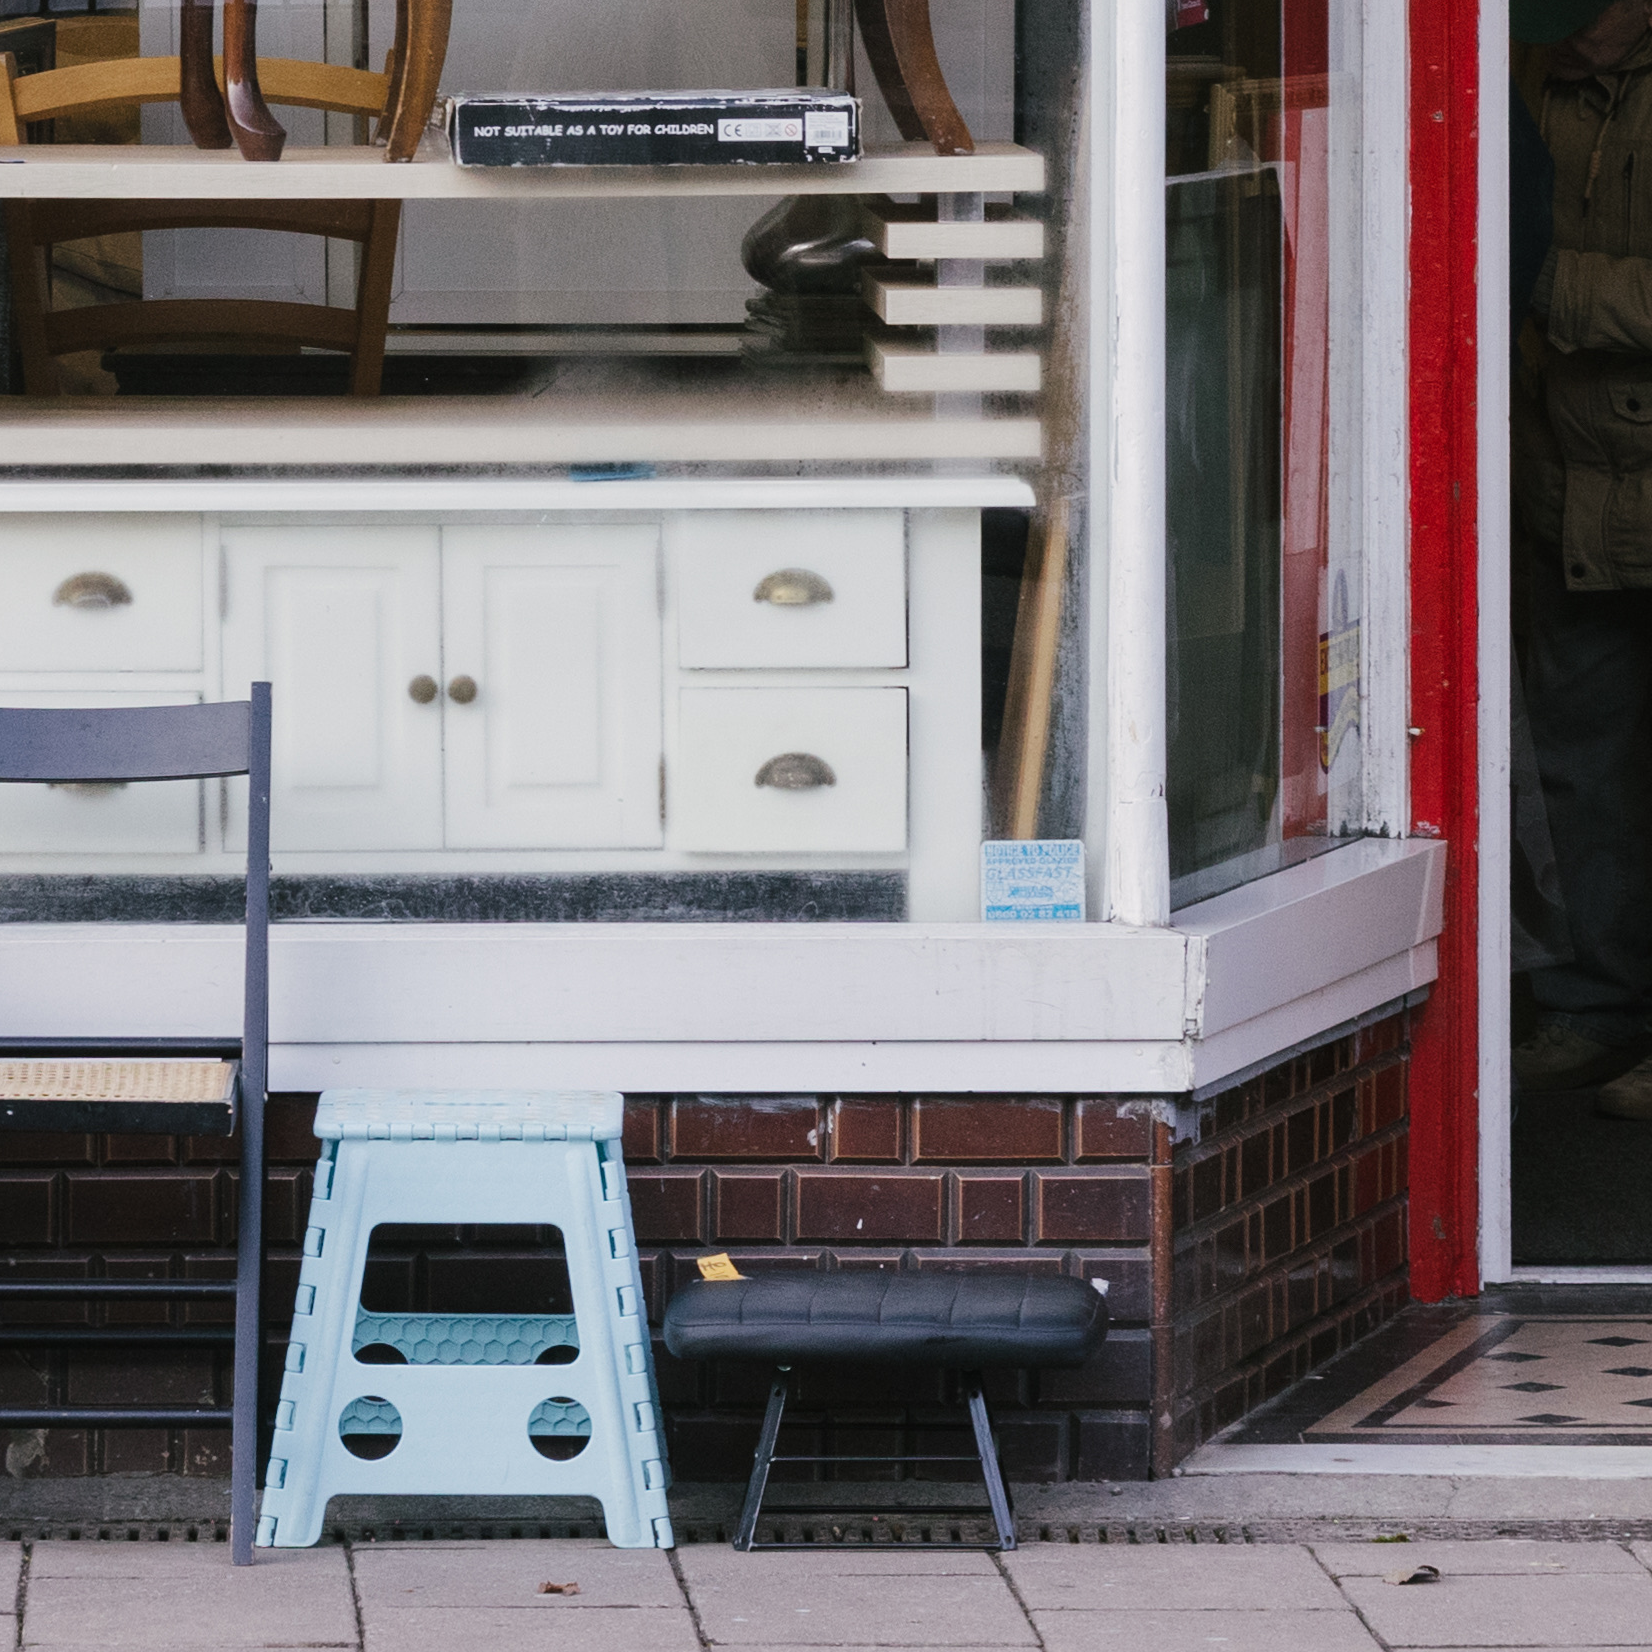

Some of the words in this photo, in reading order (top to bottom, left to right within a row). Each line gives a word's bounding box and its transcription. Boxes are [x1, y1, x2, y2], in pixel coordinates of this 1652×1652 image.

[474, 126, 501, 137] NOT
[505, 125, 563, 137] SUITABLE
[567, 125, 583, 136] AS
[587, 125, 596, 136] A
[599, 124, 624, 136] TOY
[627, 124, 651, 135] FOR
[654, 124, 714, 135] CHILDREN
